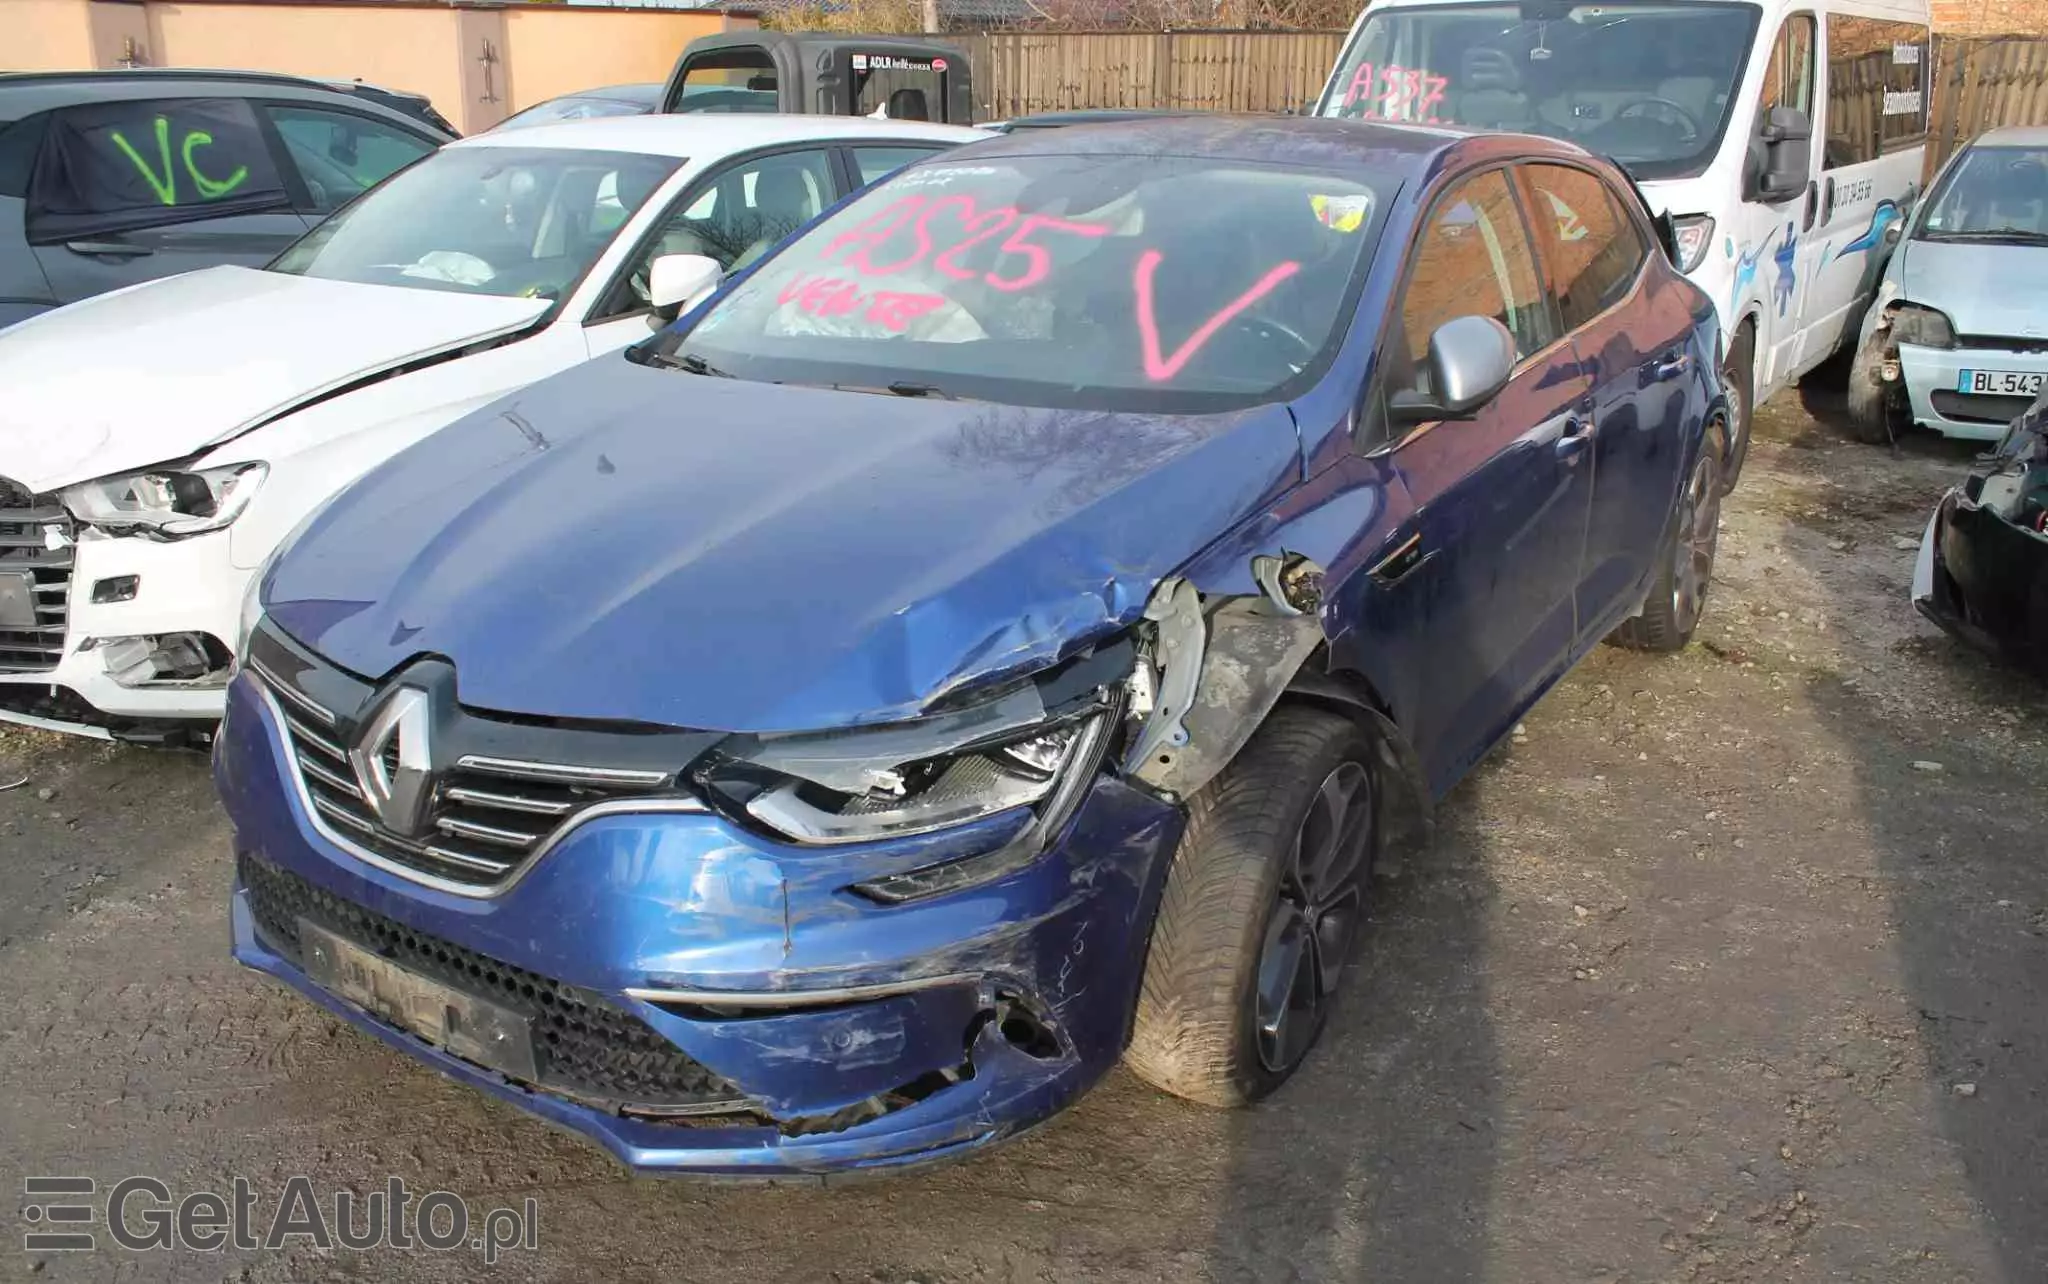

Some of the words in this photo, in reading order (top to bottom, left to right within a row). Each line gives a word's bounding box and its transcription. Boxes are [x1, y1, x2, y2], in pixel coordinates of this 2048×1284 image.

[870, 56, 892, 70] ADLR
[112, 115, 248, 206] VC
[1134, 249, 1301, 382] V
